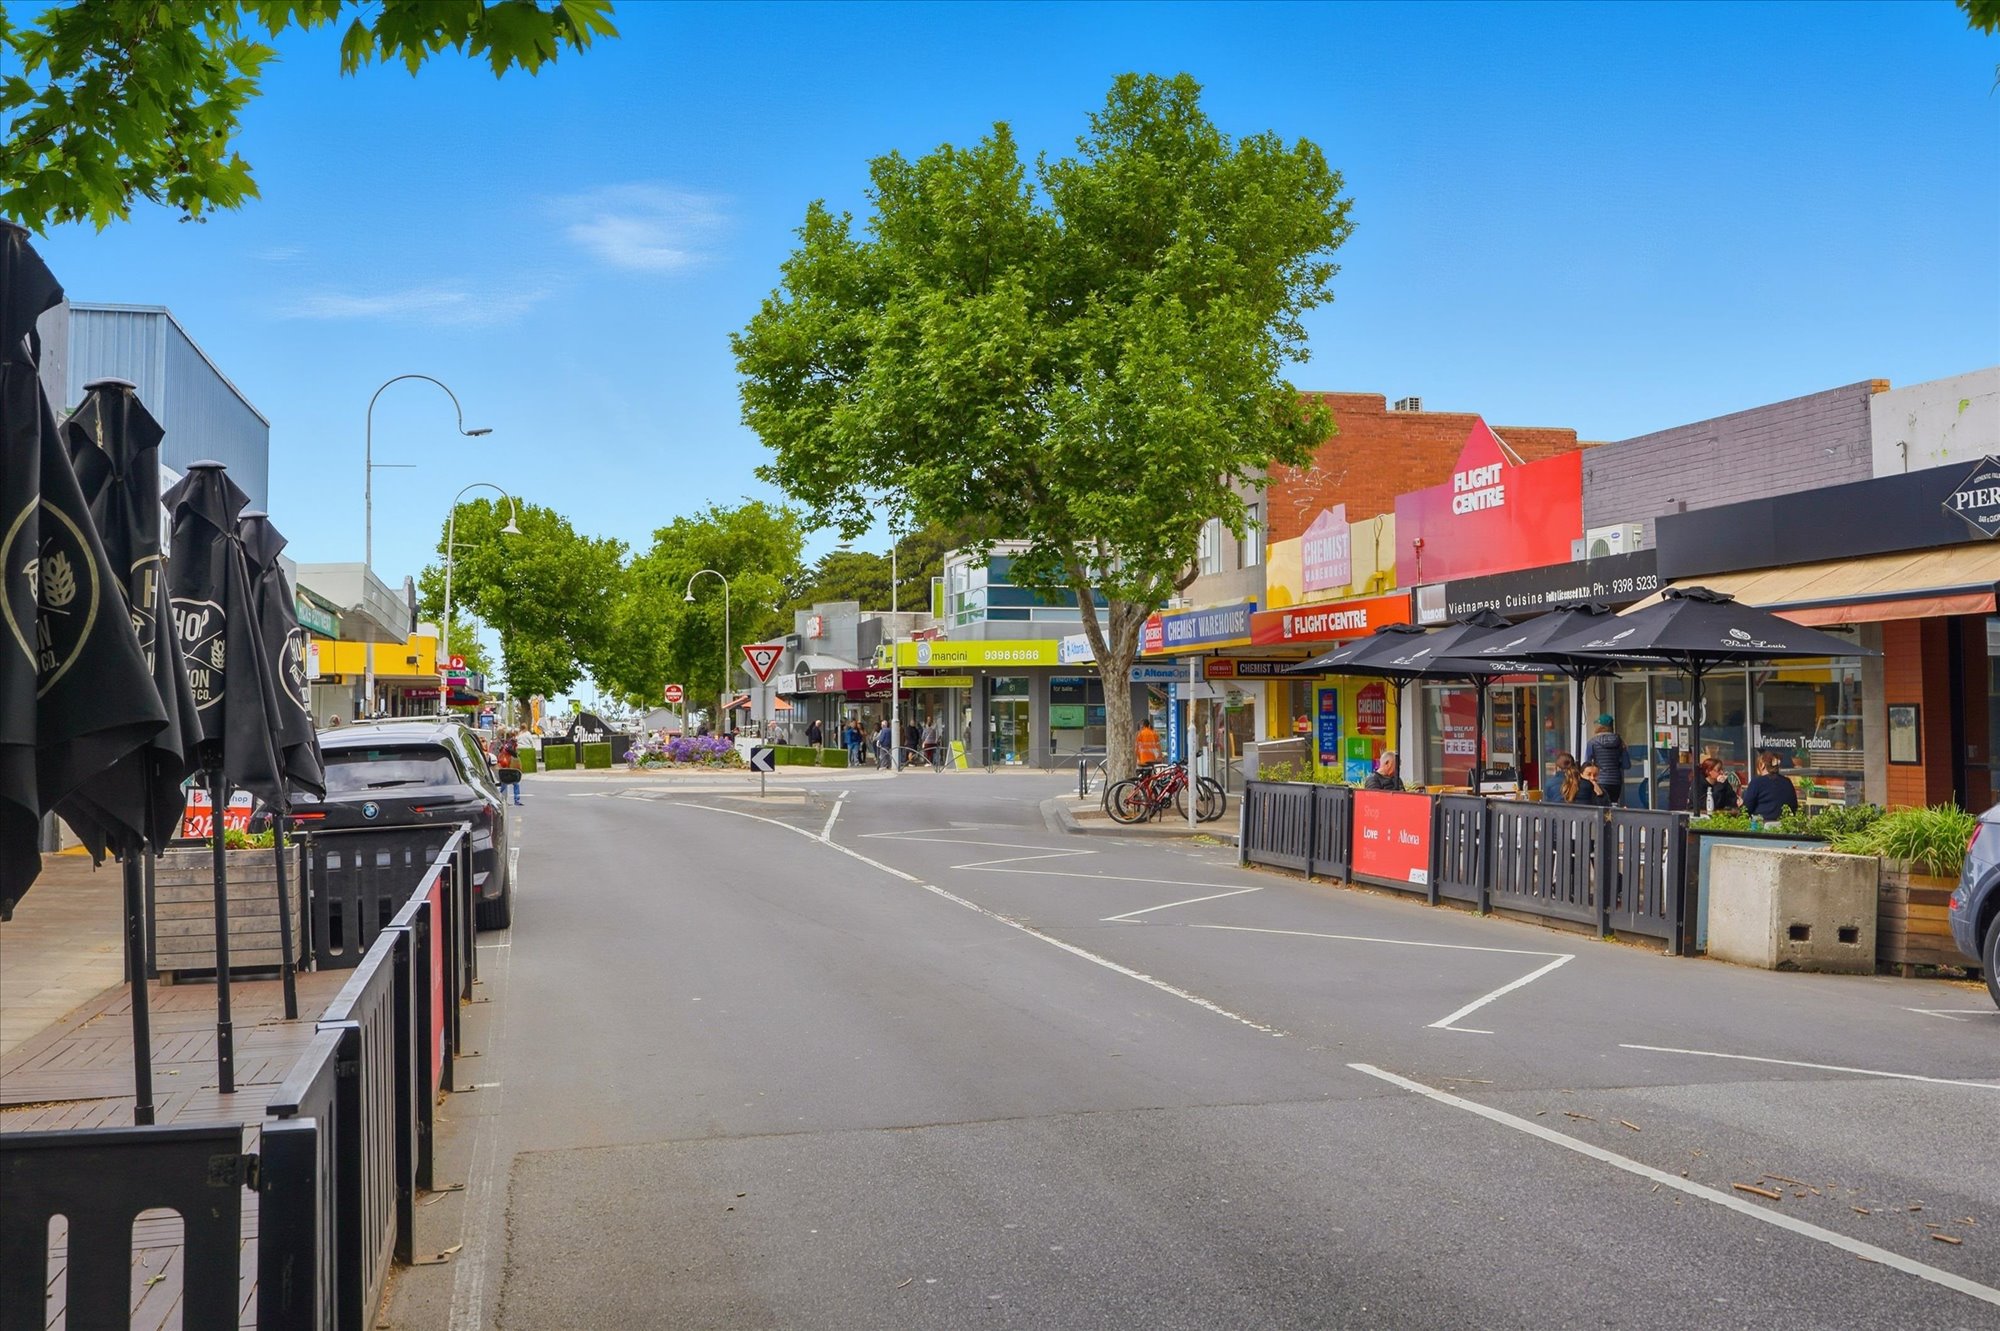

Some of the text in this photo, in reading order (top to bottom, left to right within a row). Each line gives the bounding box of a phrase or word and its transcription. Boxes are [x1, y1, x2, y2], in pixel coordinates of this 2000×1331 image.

[1454, 462, 1503, 493] FLIGHT
[1453, 485, 1505, 515] CENTRE
[1304, 533, 1348, 566] CHEMIST
[1448, 598, 1500, 615] Vietnamese
[1505, 592, 1543, 608] Cuisine
[1612, 577, 1634, 594] 9398
[1636, 575, 1658, 591] 5233
[1168, 610, 1245, 641] CHEMIST WAREHOUSE
[1294, 609, 1367, 634] FLIGHT CENTRE
[932, 651, 967, 661] mancini
[985, 650, 1010, 661] 9398
[1751, 640, 1787, 649] Louis
[1239, 663, 1272, 673] CHEMIST
[1359, 698, 1385, 713] CHEMIST
[1760, 735, 1831, 748] Vietnamese Tradition
[1363, 825, 1379, 839] Love
[1399, 828, 1420, 845] Altona
